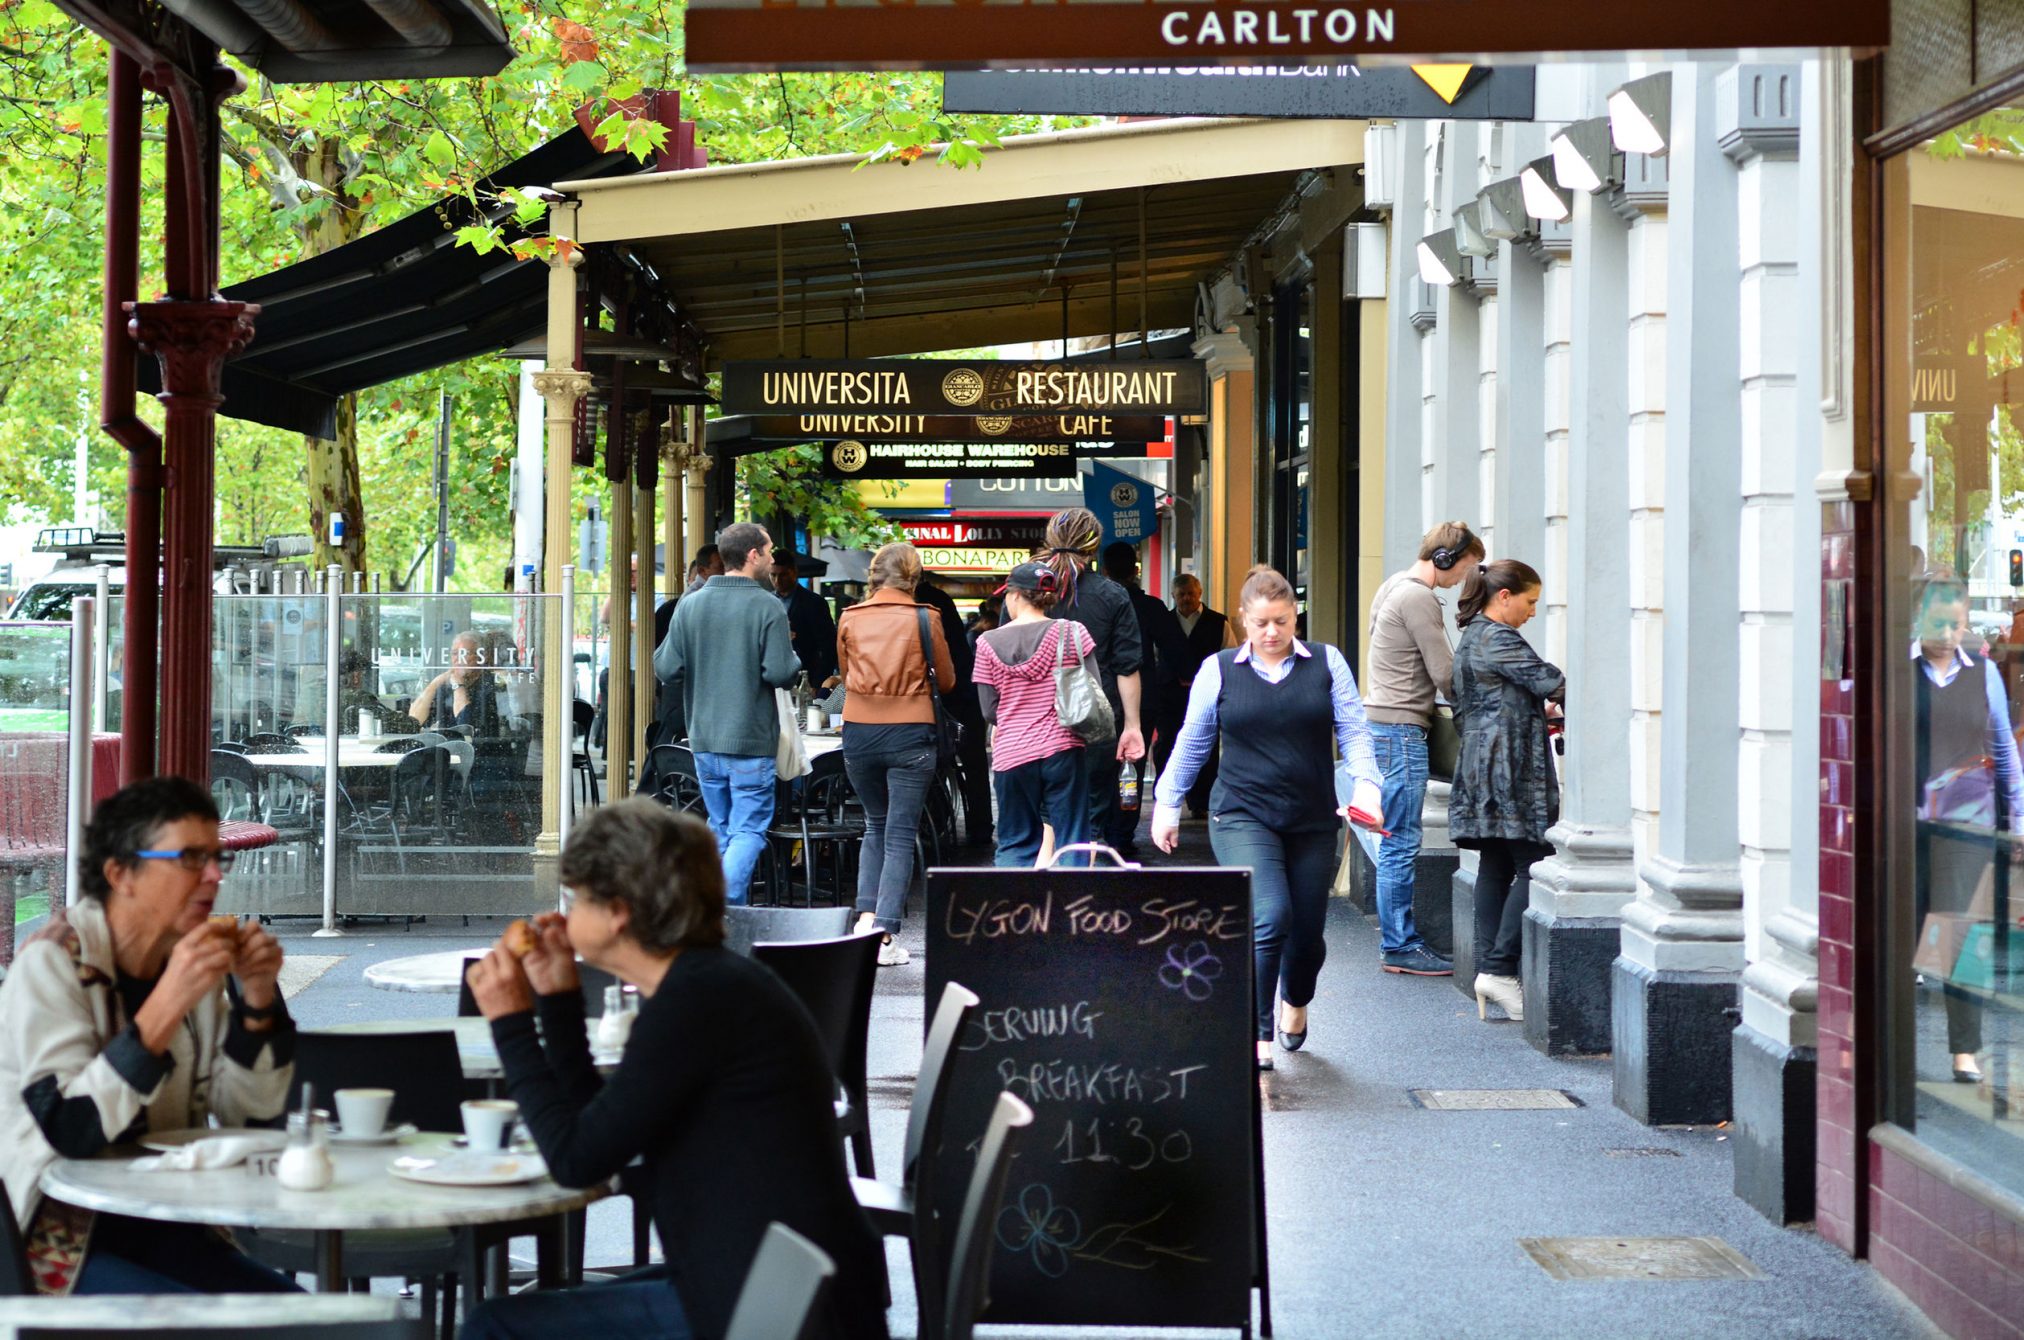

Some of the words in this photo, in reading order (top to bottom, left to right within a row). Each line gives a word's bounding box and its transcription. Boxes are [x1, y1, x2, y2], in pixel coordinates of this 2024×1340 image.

[1161, 9, 1396, 45] CARLTON
[763, 372, 911, 404] UNIVERSITA
[1017, 372, 1177, 404] RESTAURANT
[800, 415, 925, 433] UNIVERSITY
[1060, 415, 1112, 435] CAFE
[869, 444, 964, 457] HAIRHOUSE
[967, 444, 1070, 456] WAREHOUSE
[905, 460, 927, 468] HAIR
[928, 460, 958, 468] SALON
[965, 460, 991, 468] BODY
[992, 460, 1035, 468] PIERCING
[1113, 510, 1140, 519] SALON
[1114, 518, 1140, 529] NOW
[953, 524, 1002, 543] LOLLY
[1114, 528, 1142, 538] OPEN
[371, 647, 535, 665] UNIVERSITY
[494, 672, 536, 684] CAFE
[946, 891, 1052, 945] LYGON
[1065, 895, 1132, 935] FOOD
[1138, 899, 1248, 945] STORE
[997, 1057, 1208, 1104] BREAKFAST
